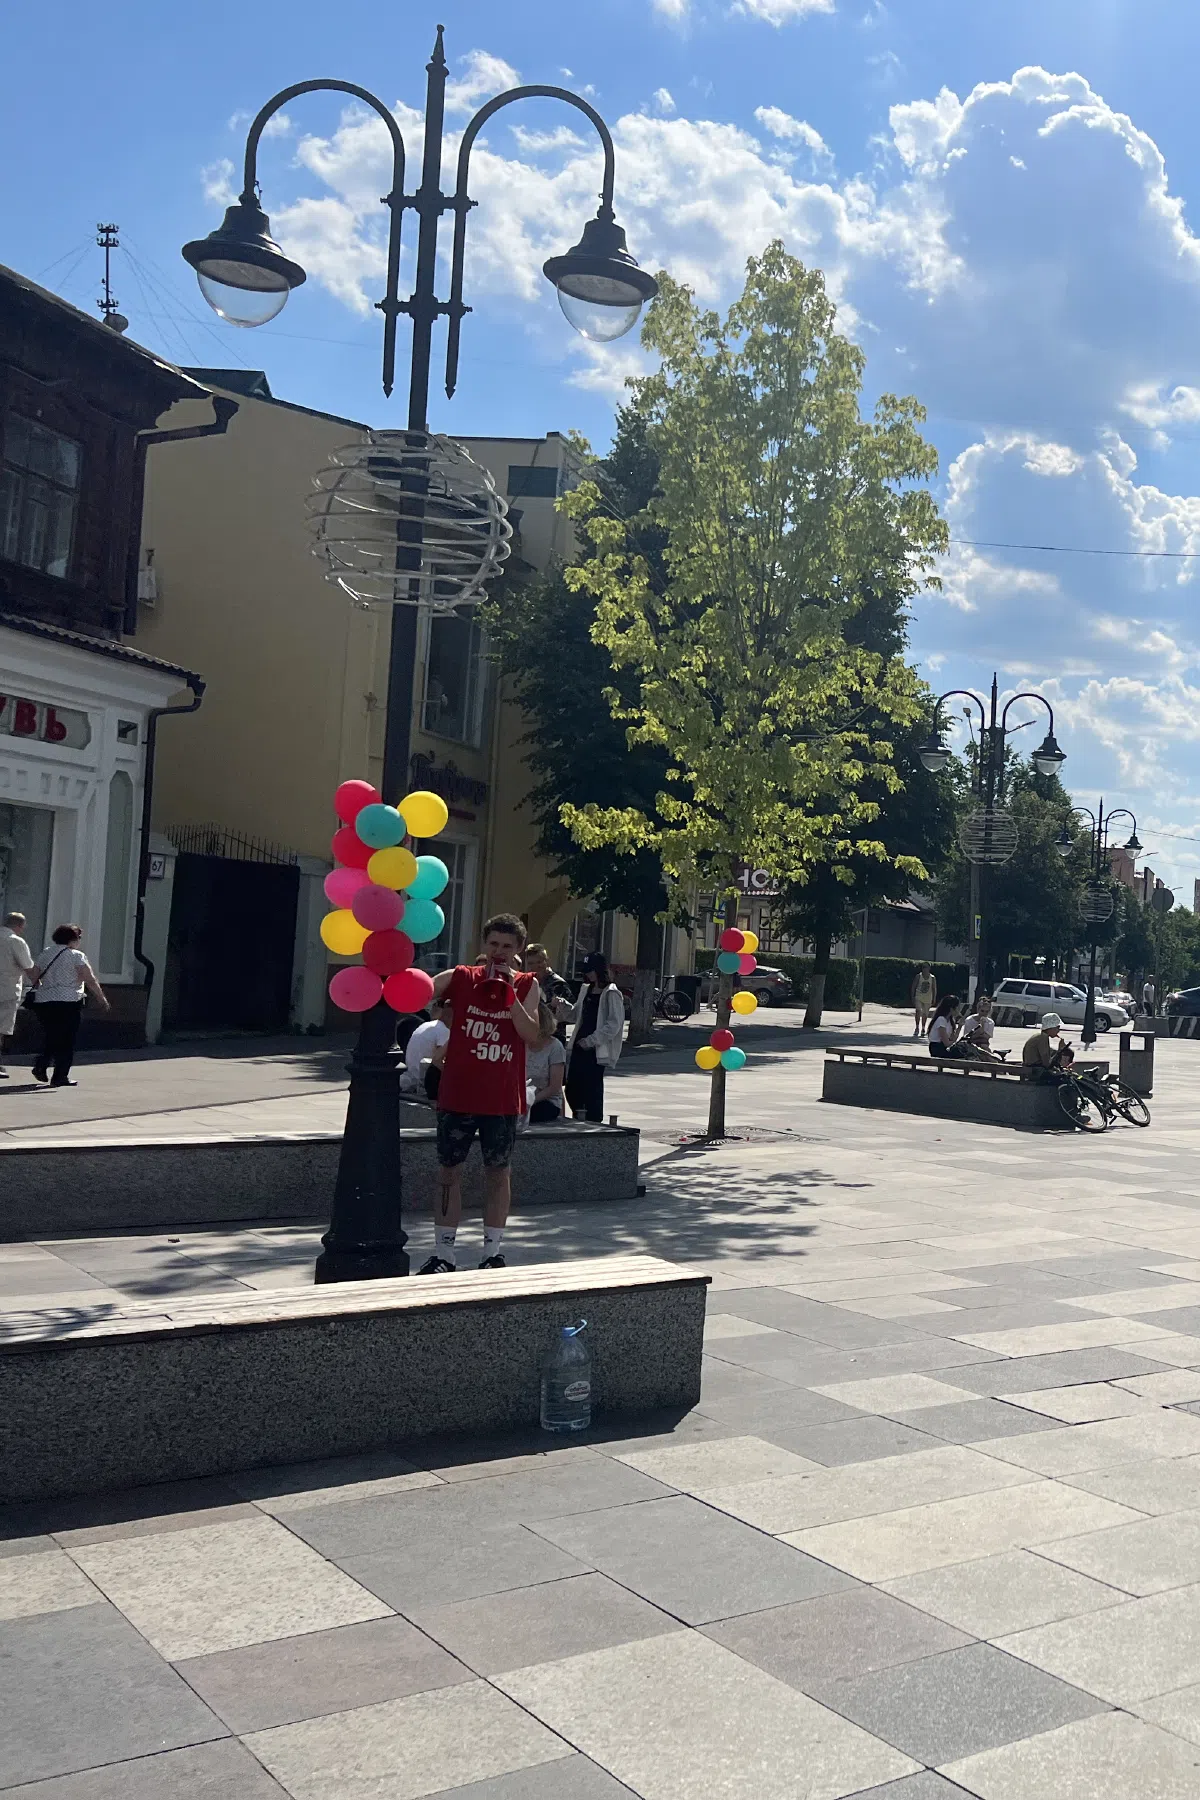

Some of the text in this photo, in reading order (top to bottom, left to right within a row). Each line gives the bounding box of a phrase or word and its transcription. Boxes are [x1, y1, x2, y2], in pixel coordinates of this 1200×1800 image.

[152, 860, 163, 871] 67
[461, 1018, 500, 1042] -70%
[470, 1042, 514, 1063] -50%
